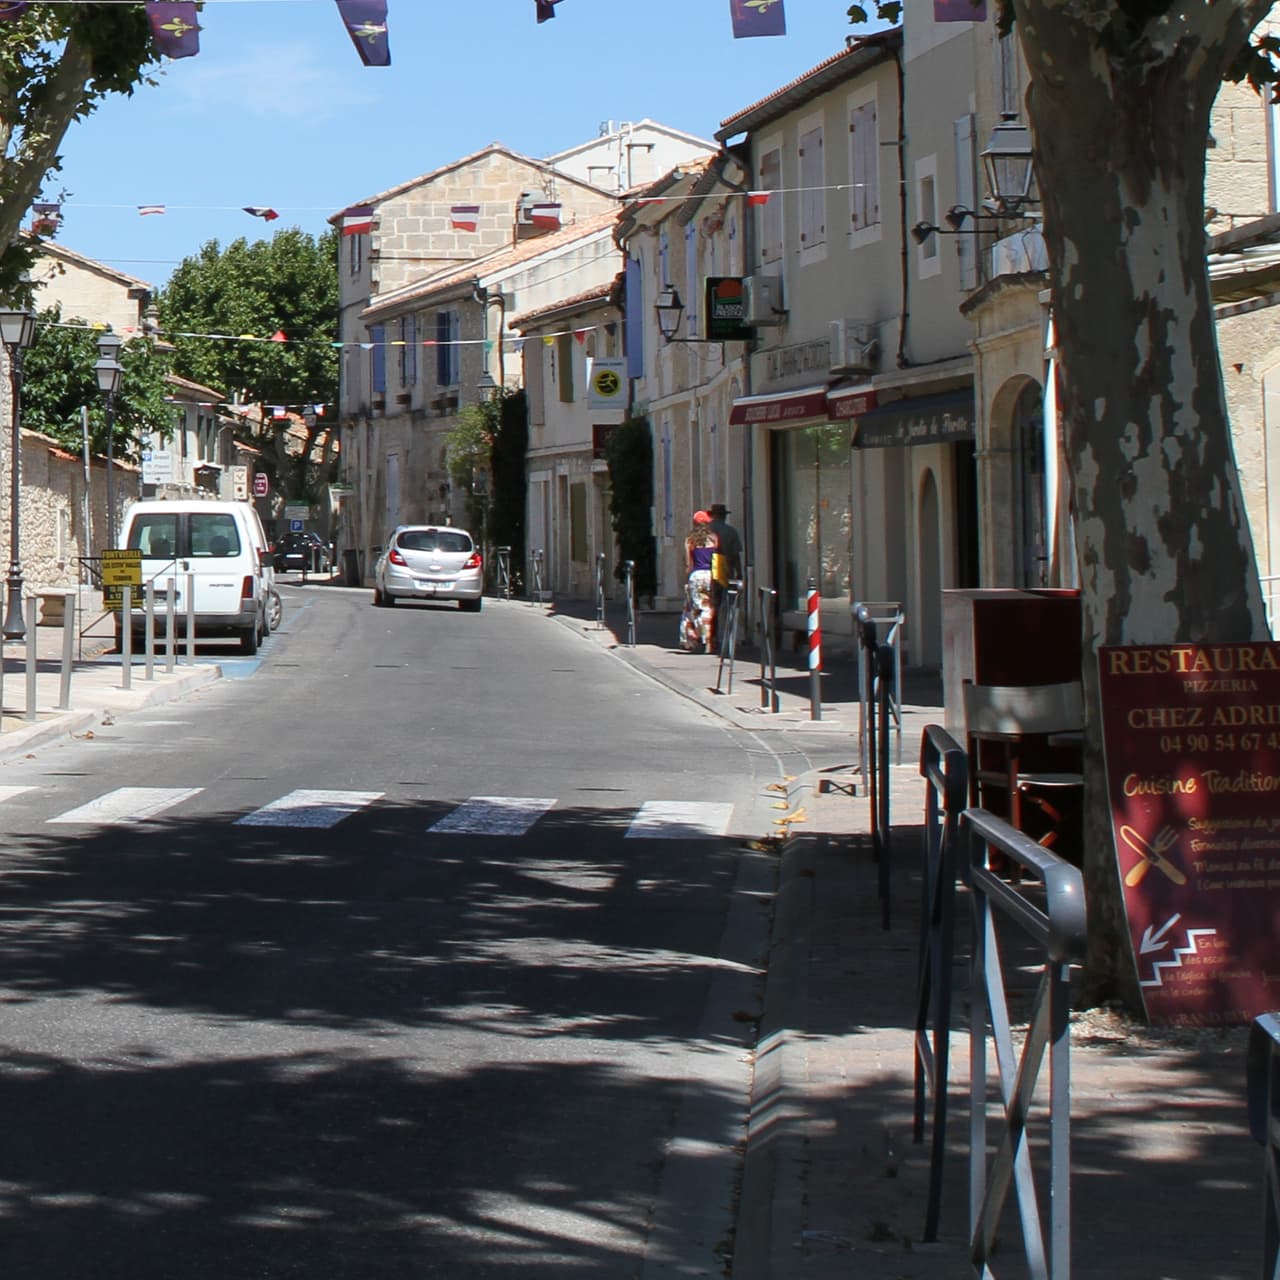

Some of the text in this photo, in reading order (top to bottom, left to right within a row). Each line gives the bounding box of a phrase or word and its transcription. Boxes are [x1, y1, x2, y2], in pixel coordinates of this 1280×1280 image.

[1109, 647, 1280, 674] RESTAURA
[1183, 680, 1258, 693] PIZZERIA
[1128, 706, 1205, 729] CHEZ
[1160, 735, 1182, 752] 04
[1187, 735, 1208, 752] 90
[1215, 734, 1235, 751] 54
[1240, 734, 1261, 750] 67
[1123, 773, 1198, 797] Cuisine
